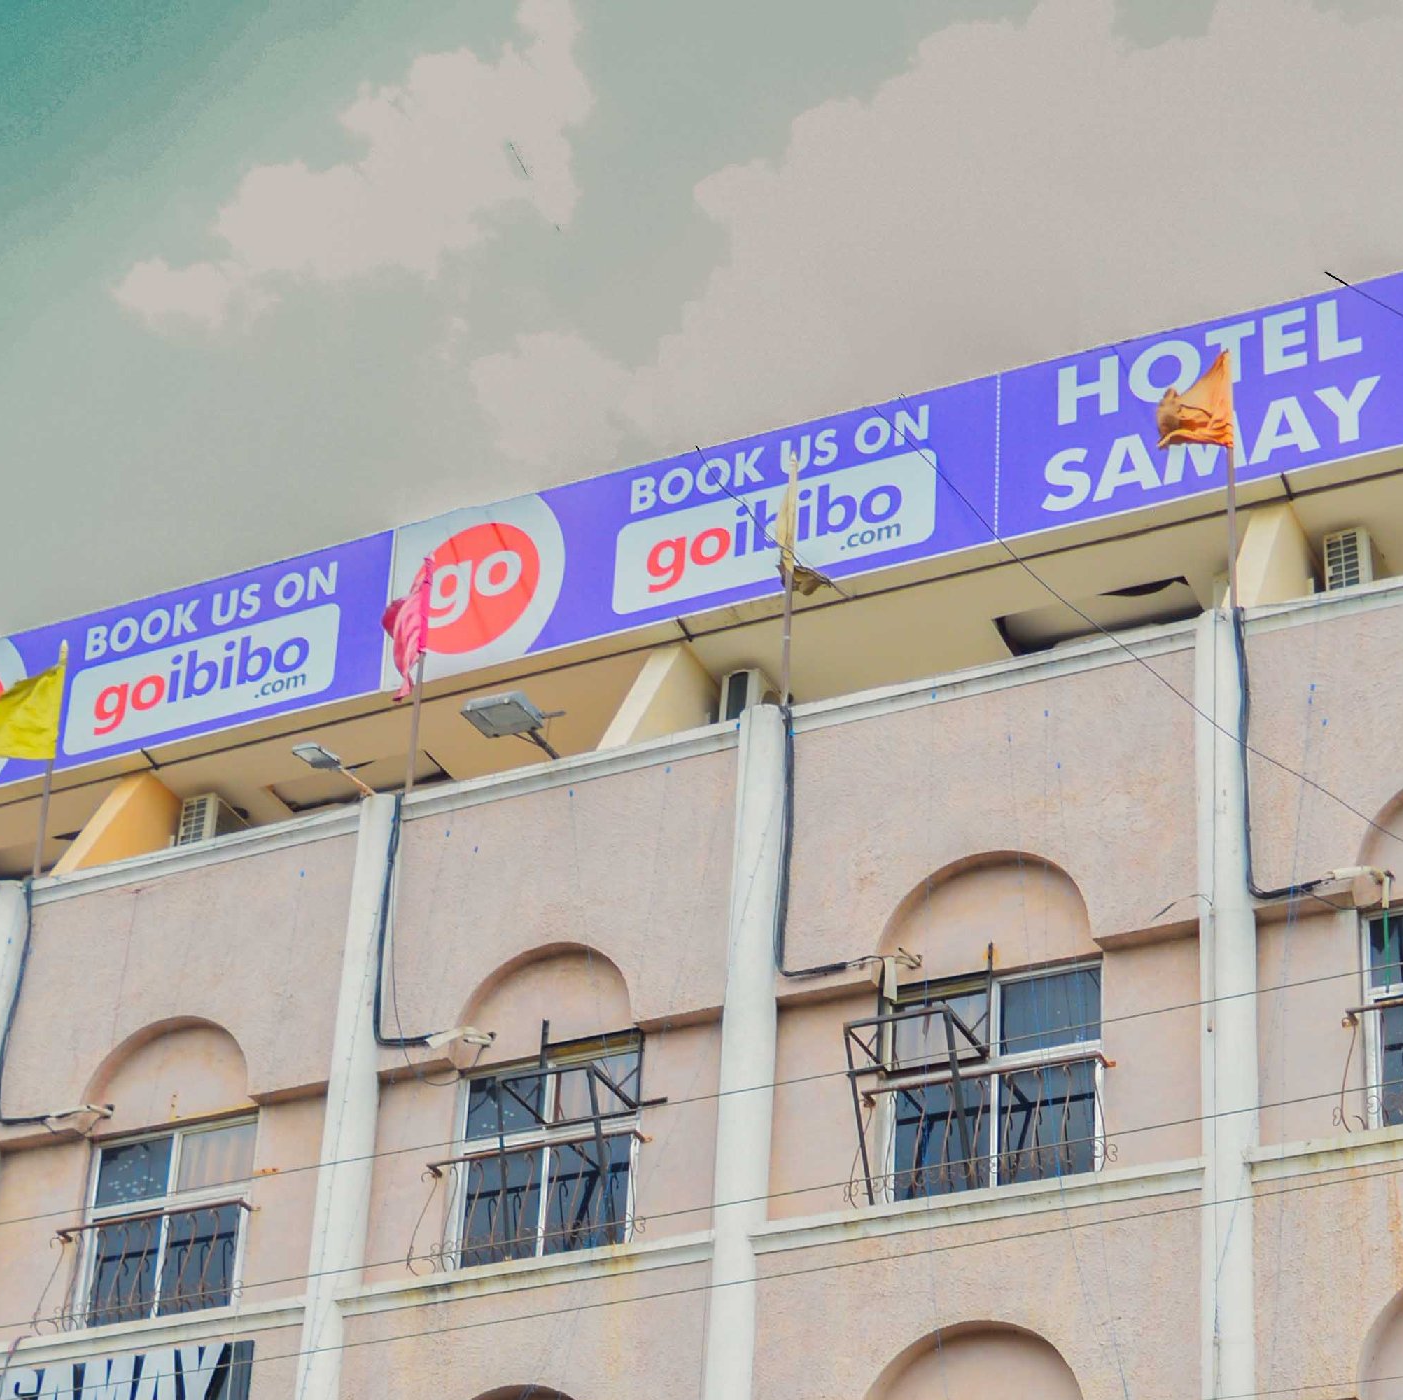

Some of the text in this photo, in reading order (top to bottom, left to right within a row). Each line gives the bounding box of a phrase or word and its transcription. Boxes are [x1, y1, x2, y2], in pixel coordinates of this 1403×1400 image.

[1057, 299, 1363, 427] HOTEL
[630, 405, 929, 514] BOOK US ON
[1040, 375, 1382, 512] SAMAY
[840, 522, 901, 550] .com
[83, 561, 340, 661] BOOK US ON
[428, 550, 520, 628] go
[93, 628, 310, 736] goibibo
[253, 670, 307, 699] .com
